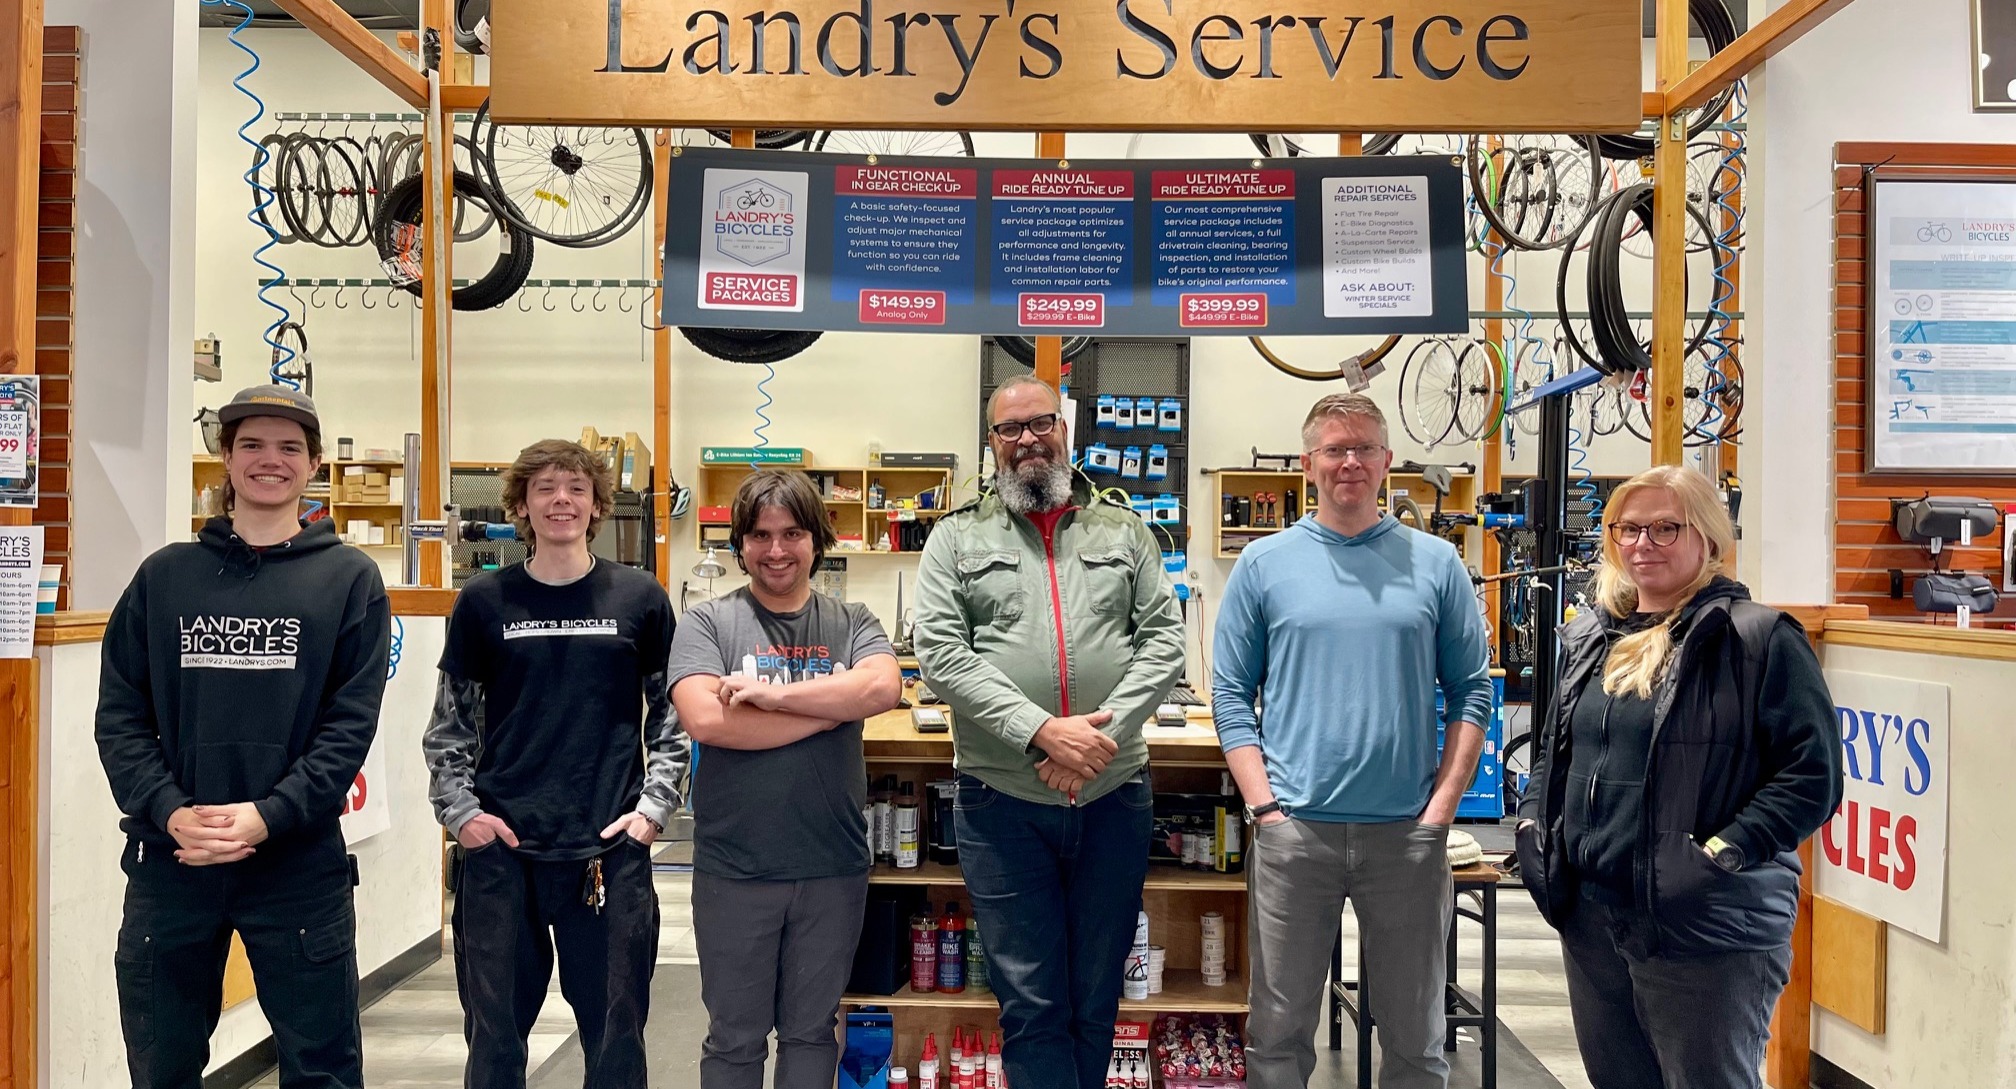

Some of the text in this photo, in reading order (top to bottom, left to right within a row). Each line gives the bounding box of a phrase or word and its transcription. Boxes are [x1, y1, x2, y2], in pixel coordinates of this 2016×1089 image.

[594, 0, 1531, 106] Landry's Service
[857, 169, 955, 182] FUNCTIONAL
[1031, 174, 1094, 184] ANNUAL
[1186, 174, 1260, 184] ULTIMATE
[866, 182, 898, 191] GEAR
[902, 183, 942, 192] CHECK
[1002, 185, 1125, 194] RIDE READY TUNE UP
[1161, 185, 1286, 194] RIDE READY TUNE UP
[1338, 185, 1413, 194] ADDITIONAL
[889, 203, 960, 213] safety-focused
[1011, 205, 1050, 214] Landry's
[1079, 206, 1115, 215] popular
[1211, 205, 1282, 214] comprehensive
[716, 211, 794, 224] LANDRY'S
[844, 214, 890, 223] check-up.
[911, 216, 945, 224] inspect
[1036, 218, 1076, 227] package
[1080, 218, 1124, 226] optimizes
[1200, 218, 1241, 227] package
[1963, 222, 2015, 231] LANDRY'S
[715, 223, 793, 236] BICYCLES
[848, 227, 876, 235] adjust
[880, 228, 906, 236] major
[1214, 229, 1255, 238] services,
[1032, 230, 1090, 239] adjustments
[1969, 232, 2009, 241] BICYCLES
[850, 239, 888, 247] systems
[938, 241, 958, 249] they
[999, 241, 1058, 250] performance
[1082, 242, 1125, 251] longevity.
[1207, 242, 1249, 250] cleaning,
[1252, 241, 1288, 250] bearing
[848, 250, 886, 259] function
[1083, 254, 1122, 263] cleaning
[1159, 254, 1211, 262] inspection,
[888, 264, 941, 272] confidence.
[1181, 266, 1206, 275] parts
[712, 277, 790, 291] SERVICE
[1054, 278, 1081, 287] repair
[1085, 279, 1111, 287] parts.
[1187, 278, 1222, 287] original
[1225, 278, 1288, 287] performance.
[1341, 283, 1414, 292] ASK ABOUT:
[712, 291, 790, 302] PACKAGES
[869, 295, 936, 308] $149.99
[1026, 298, 1096, 312] $249.99
[1188, 298, 1259, 312] $399.99
[876, 311, 906, 319] Analog
[180, 616, 301, 635] LANDRY'S
[503, 619, 617, 631] LANDRY'S BICYCLES
[181, 634, 298, 654] BICYCLES
